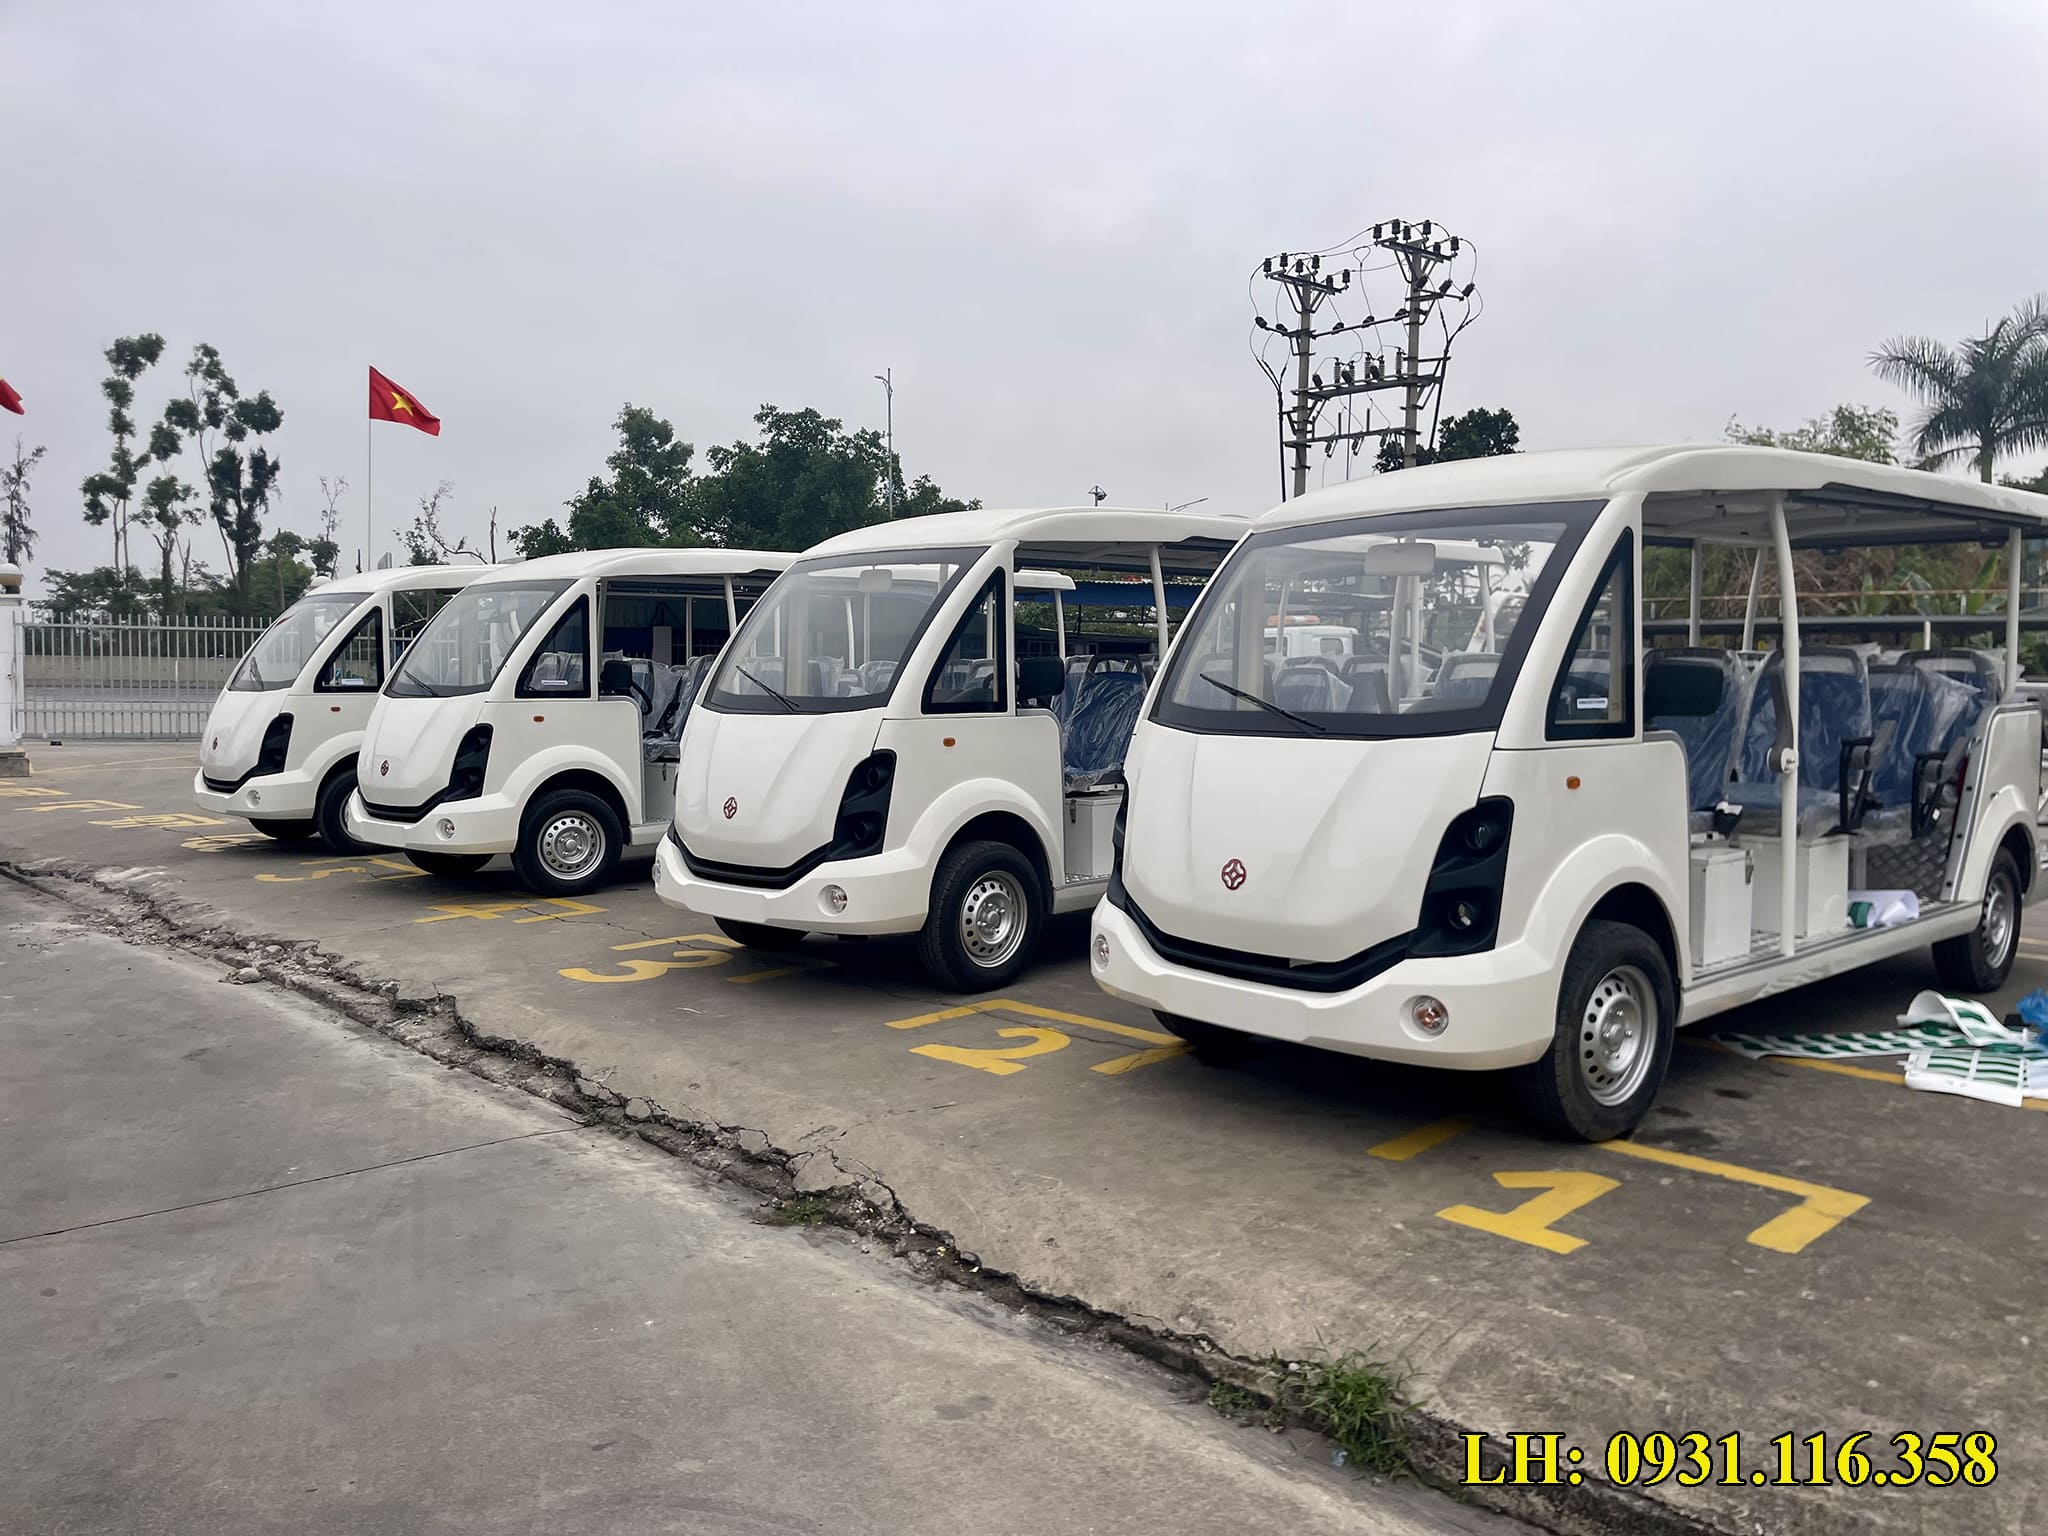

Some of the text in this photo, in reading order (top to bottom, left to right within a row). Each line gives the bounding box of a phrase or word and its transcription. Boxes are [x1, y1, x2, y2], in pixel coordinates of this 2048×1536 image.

[558, 950, 734, 984] 3
[909, 1026, 1073, 1076] 2
[1435, 1169, 1622, 1256] 1
